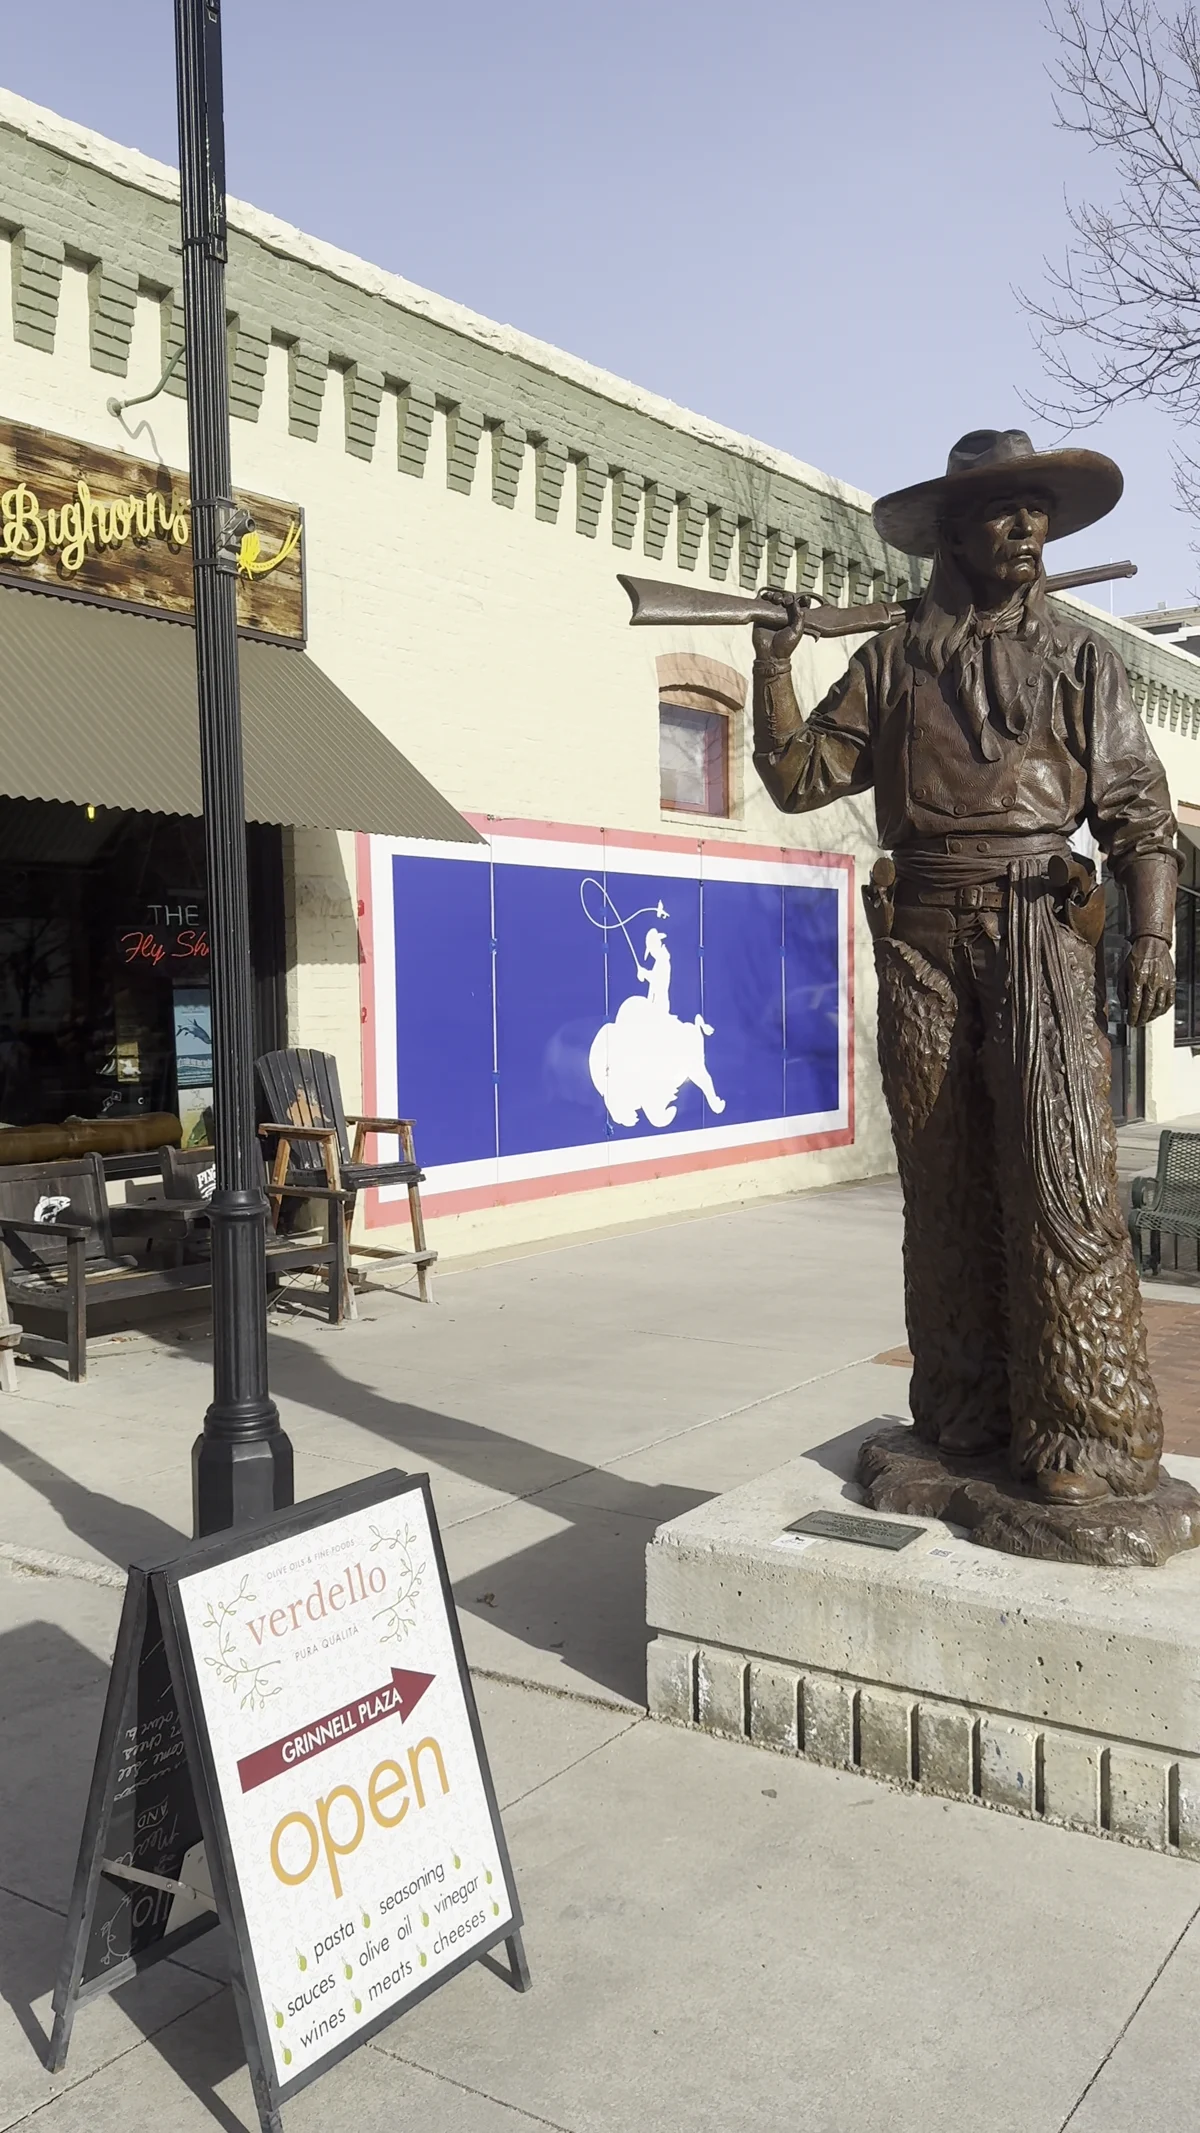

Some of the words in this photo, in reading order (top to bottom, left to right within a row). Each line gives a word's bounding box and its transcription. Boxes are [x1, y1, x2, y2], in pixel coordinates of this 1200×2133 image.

[0, 480, 188, 571] Bighorns
[121, 931, 166, 966] Fly
[171, 930, 210, 957] Sh
[147, 905, 199, 926] THE
[266, 1564, 287, 1580] OLIVE
[289, 1558, 305, 1571] OILS
[307, 1556, 312, 1564] &
[314, 1548, 329, 1560] FINE
[331, 1538, 355, 1553] FOODS
[245, 1562, 387, 1646] verdello
[294, 1644, 319, 1662] PURA
[281, 1710, 357, 1764] GRINNELL
[357, 1687, 404, 1724] PLAZA
[137, 1800, 169, 1829] AND
[269, 1736, 450, 1900] open
[287, 1973, 336, 2017] sauces
[358, 1936, 390, 1967] olive
[396, 1915, 413, 1941] oil
[433, 1876, 479, 1914] vinegar
[313, 1920, 355, 1964] pasta
[378, 1863, 446, 1915] seasoning
[299, 2008, 346, 2048] wines
[368, 1960, 413, 2002] meats
[432, 1909, 487, 1955] cheeses
